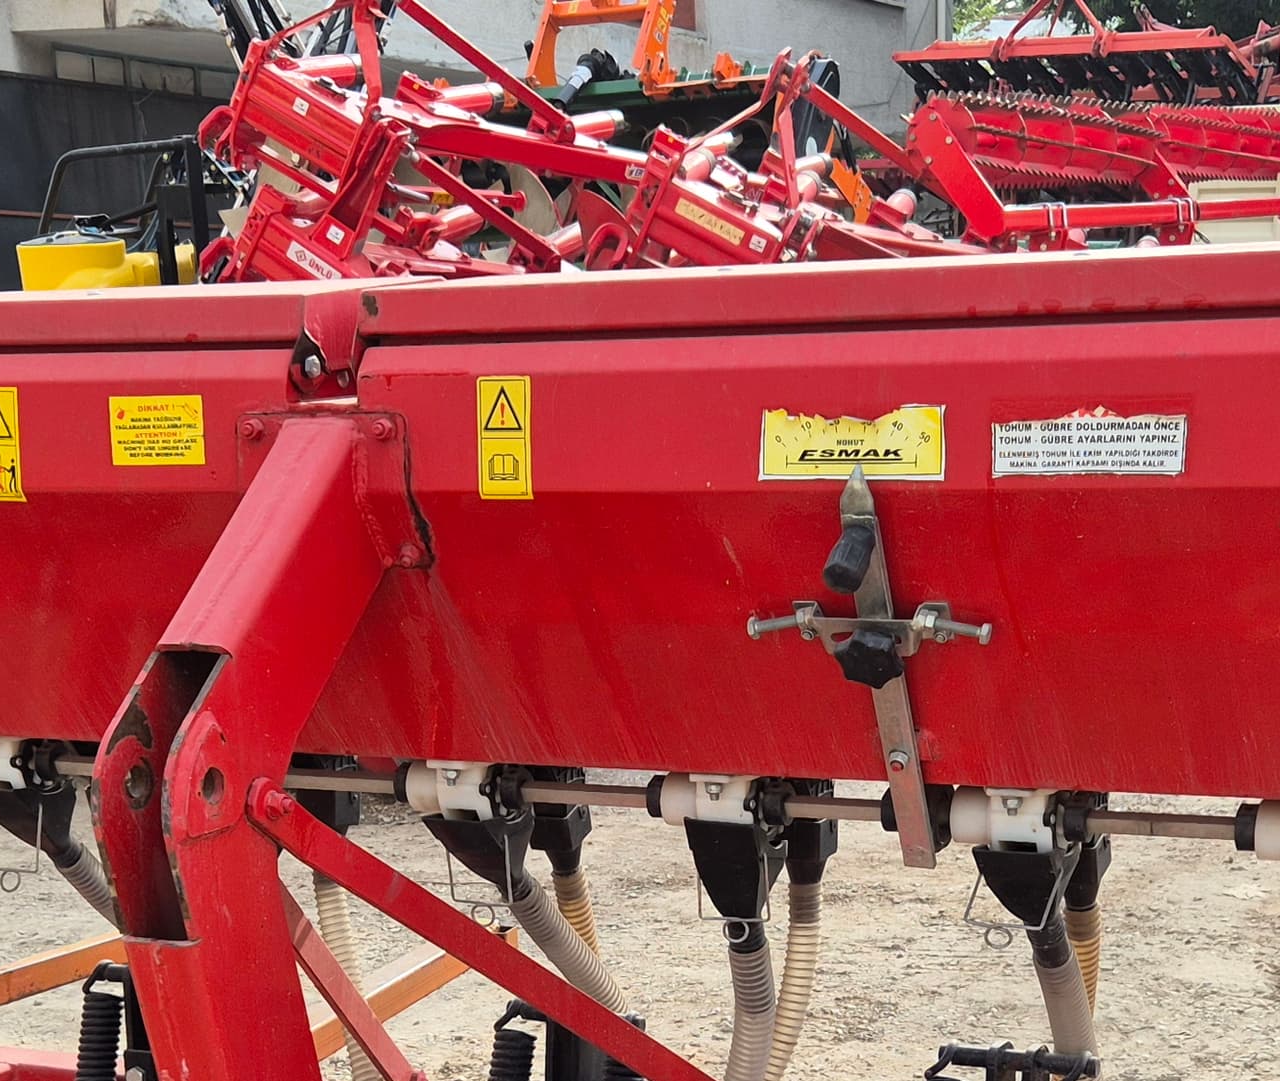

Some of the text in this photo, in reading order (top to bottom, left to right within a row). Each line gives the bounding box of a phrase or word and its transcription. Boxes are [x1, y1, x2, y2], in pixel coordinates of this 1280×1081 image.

[999, 423, 1032, 432] TOHUM
[1040, 421, 1072, 431] GÜBRE
[1076, 422, 1151, 431] DOLDURMADAN
[1154, 419, 1180, 431] ÖNCE
[775, 435, 782, 443] 0
[801, 421, 812, 432] 10
[891, 420, 904, 431] 40
[919, 431, 931, 444] 50
[999, 436, 1032, 444] TOHUM
[1041, 434, 1073, 444] GÜBRE
[1077, 435, 1136, 444] AYARLARINI
[798, 449, 903, 461] ESMAK
[1070, 449, 1080, 457] İLE
